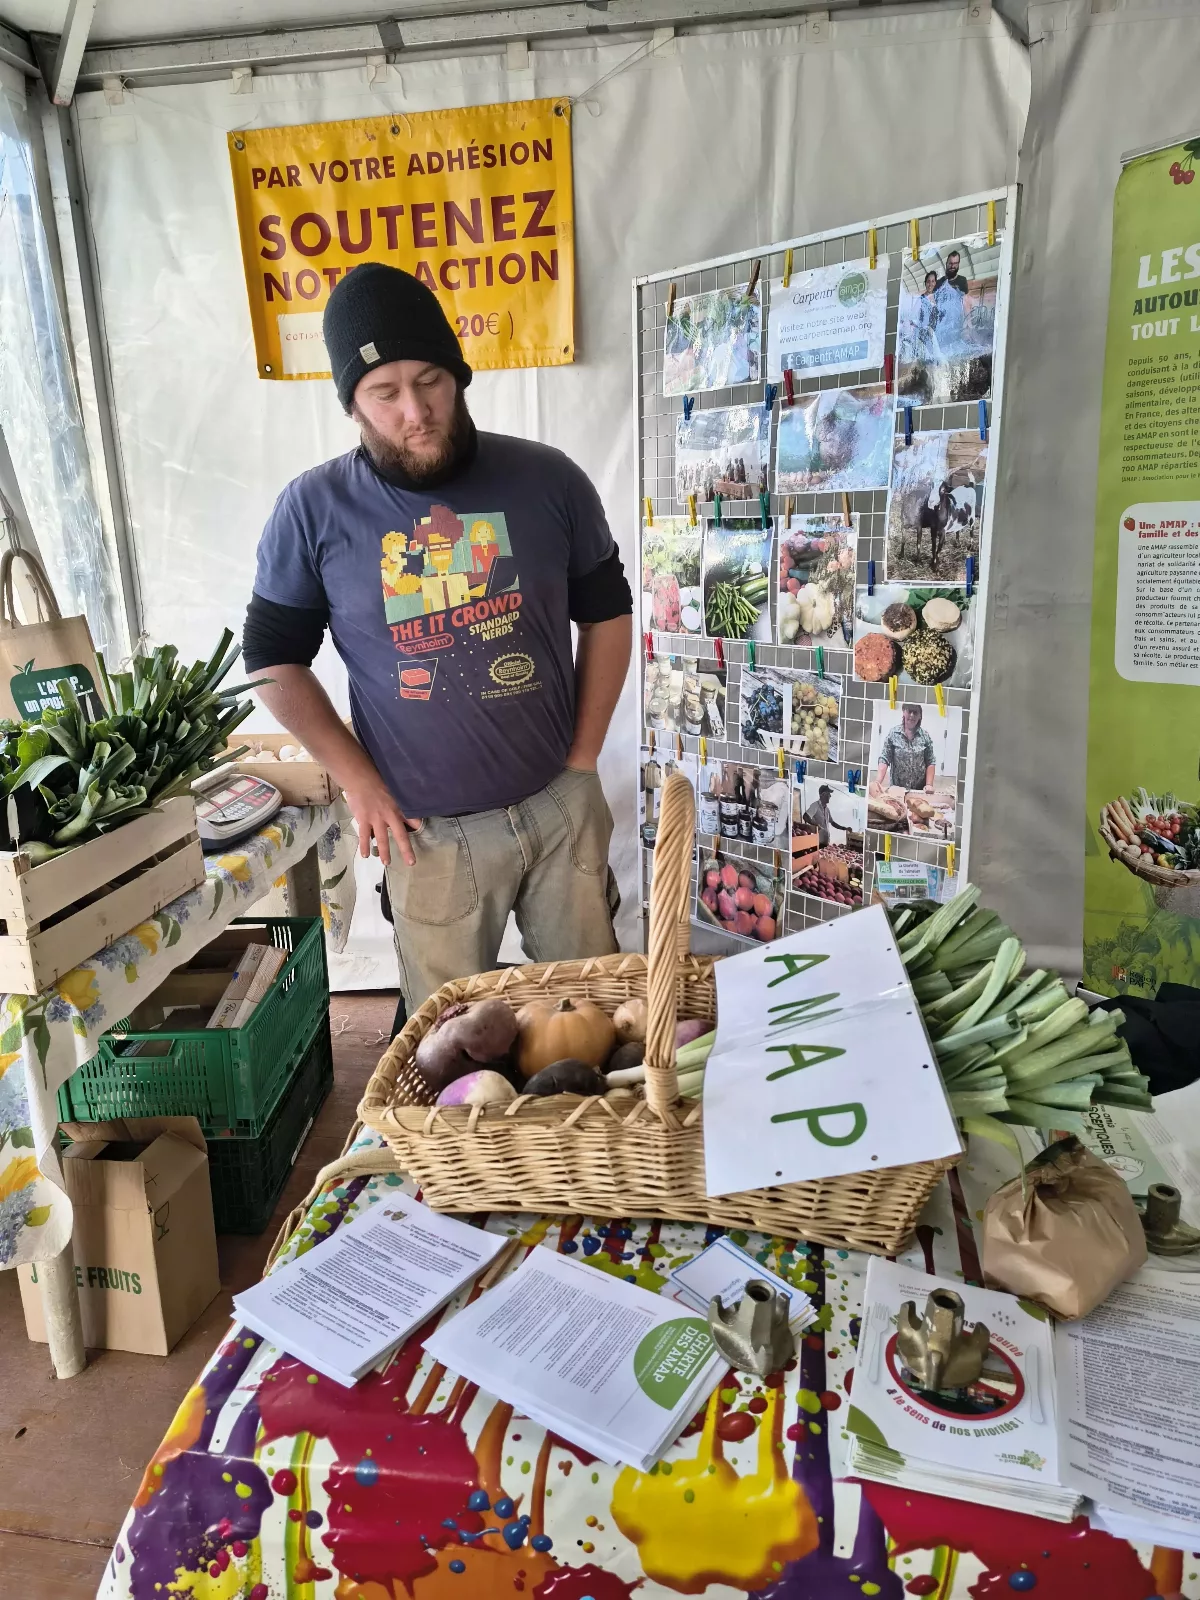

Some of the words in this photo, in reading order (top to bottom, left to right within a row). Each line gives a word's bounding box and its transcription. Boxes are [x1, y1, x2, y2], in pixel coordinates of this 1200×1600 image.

[252, 166, 300, 190] PAR
[309, 156, 396, 184] VOTRE
[406, 138, 554, 176] ADHÉSION
[258, 190, 556, 261] SOUTENEZ
[264, 266, 358, 302] NOT
[412, 249, 559, 292] ACTION
[840, 282, 864, 296] amap
[1132, 288, 1200, 316] AUTOU
[780, 322, 804, 334] Visitez
[806, 318, 828, 328] notre
[830, 315, 844, 324] site
[846, 311, 867, 321] web!
[1131, 317, 1180, 340] TOUT
[795, 346, 860, 366] Carpentr'AMAP
[1128, 356, 1153, 366] Depuis
[1159, 355, 1168, 363] 50
[1128, 365, 1170, 376] conduisant
[1127, 376, 1175, 388] dangereuses
[1126, 390, 1155, 399] saisons,
[1126, 398, 1172, 409] alimentaire,
[1149, 419, 1182, 428] citoyens
[1136, 431, 1157, 440] AMAP
[1171, 429, 1189, 437] sont
[1123, 452, 1187, 461] consommateurs.
[1124, 442, 1173, 452] respectueuse
[1161, 461, 1198, 470] réparties
[1139, 530, 1168, 538] famille
[390, 620, 424, 642] THE
[430, 614, 446, 634] IT
[451, 592, 522, 628] CROWD
[469, 611, 520, 636] STANDARD
[482, 624, 514, 641] NERDS
[400, 636, 449, 653] Reynholm
[764, 953, 868, 1147] AMAP
[1103, 1112, 1116, 1128] amis
[1088, 1106, 1116, 1155] SCEPTIQUES
[87, 1267, 142, 1295] FRUITS
[678, 1326, 699, 1347] DES
[653, 1347, 682, 1383] AMAP
[672, 1333, 710, 1377] CHARTE
[893, 1396, 906, 1405] le
[904, 1403, 930, 1424] sens
[932, 1421, 946, 1431] de
[950, 1426, 971, 1437] nos
[973, 1418, 1018, 1438] priorités
